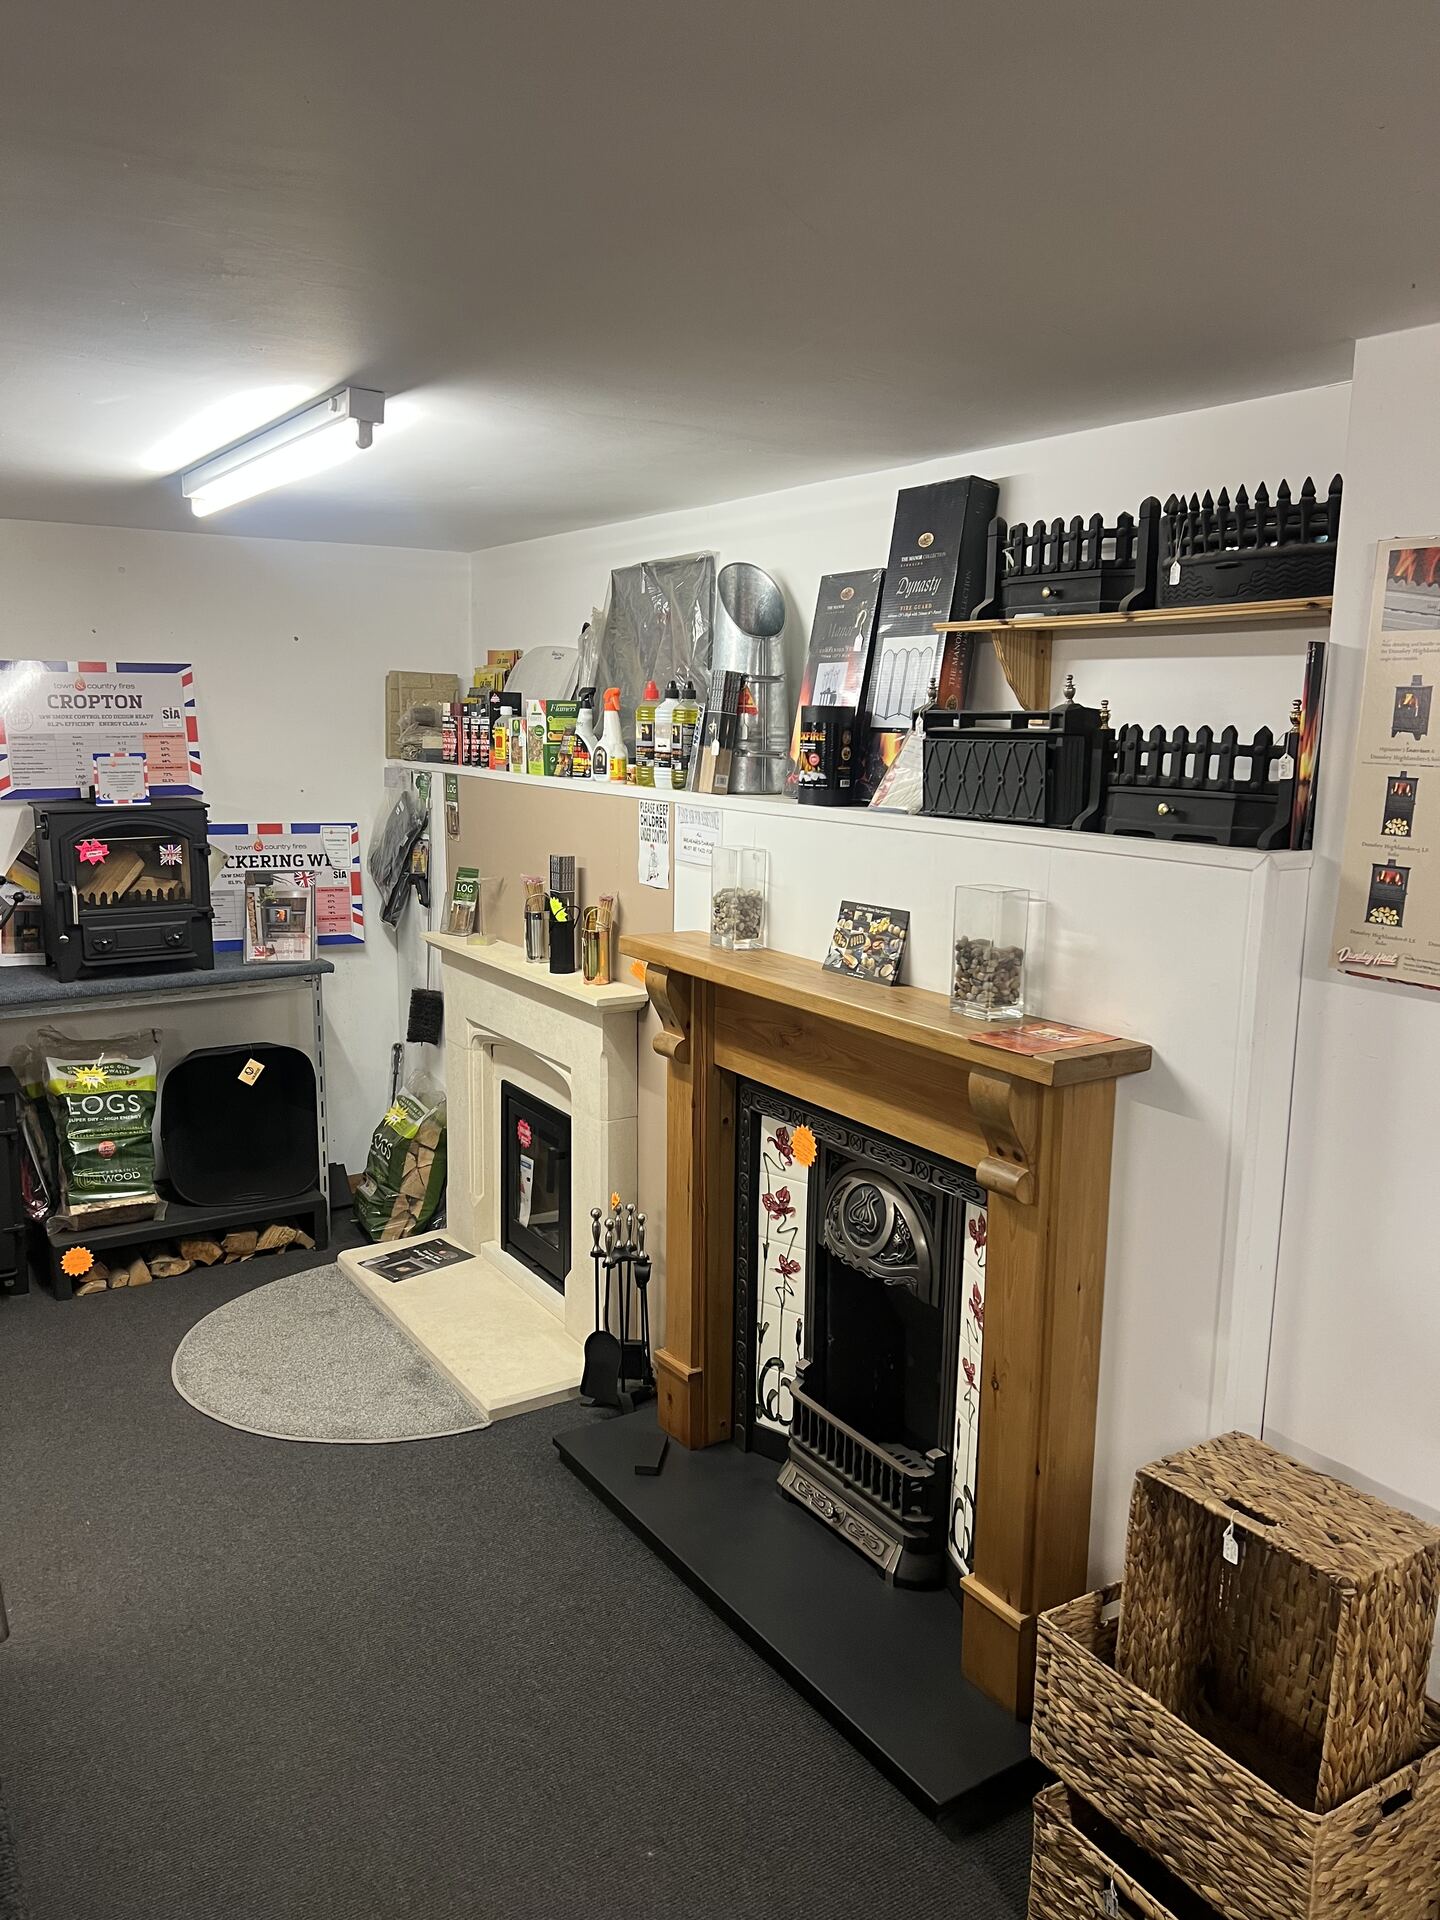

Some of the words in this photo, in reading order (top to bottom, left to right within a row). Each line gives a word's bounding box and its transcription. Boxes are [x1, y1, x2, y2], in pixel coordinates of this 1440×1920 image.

[896, 575, 942, 599] Dynasty
[913, 602, 933, 610] GUARD
[951, 631, 963, 666] MANOR
[949, 670, 957, 686] THE
[86, 682, 117, 690] country
[118, 682, 136, 690] fires
[47, 694, 144, 709] CROPTON
[550, 703, 577, 712] Flamers
[447, 785, 457, 794] LOG
[640, 801, 656, 815] PLEASE
[656, 803, 668, 816] KEEP
[640, 813, 667, 829] CHILDREN
[640, 827, 652, 842] UNDER
[222, 854, 304, 869] CKERING
[456, 883, 474, 893] LOG
[1337, 946, 1376, 966] Dunsley
[1375, 951, 1399, 967] Heat
[66, 1094, 141, 1115] LOGS
[371, 1133, 393, 1160] OGS
[102, 1171, 141, 1183] WOOD
